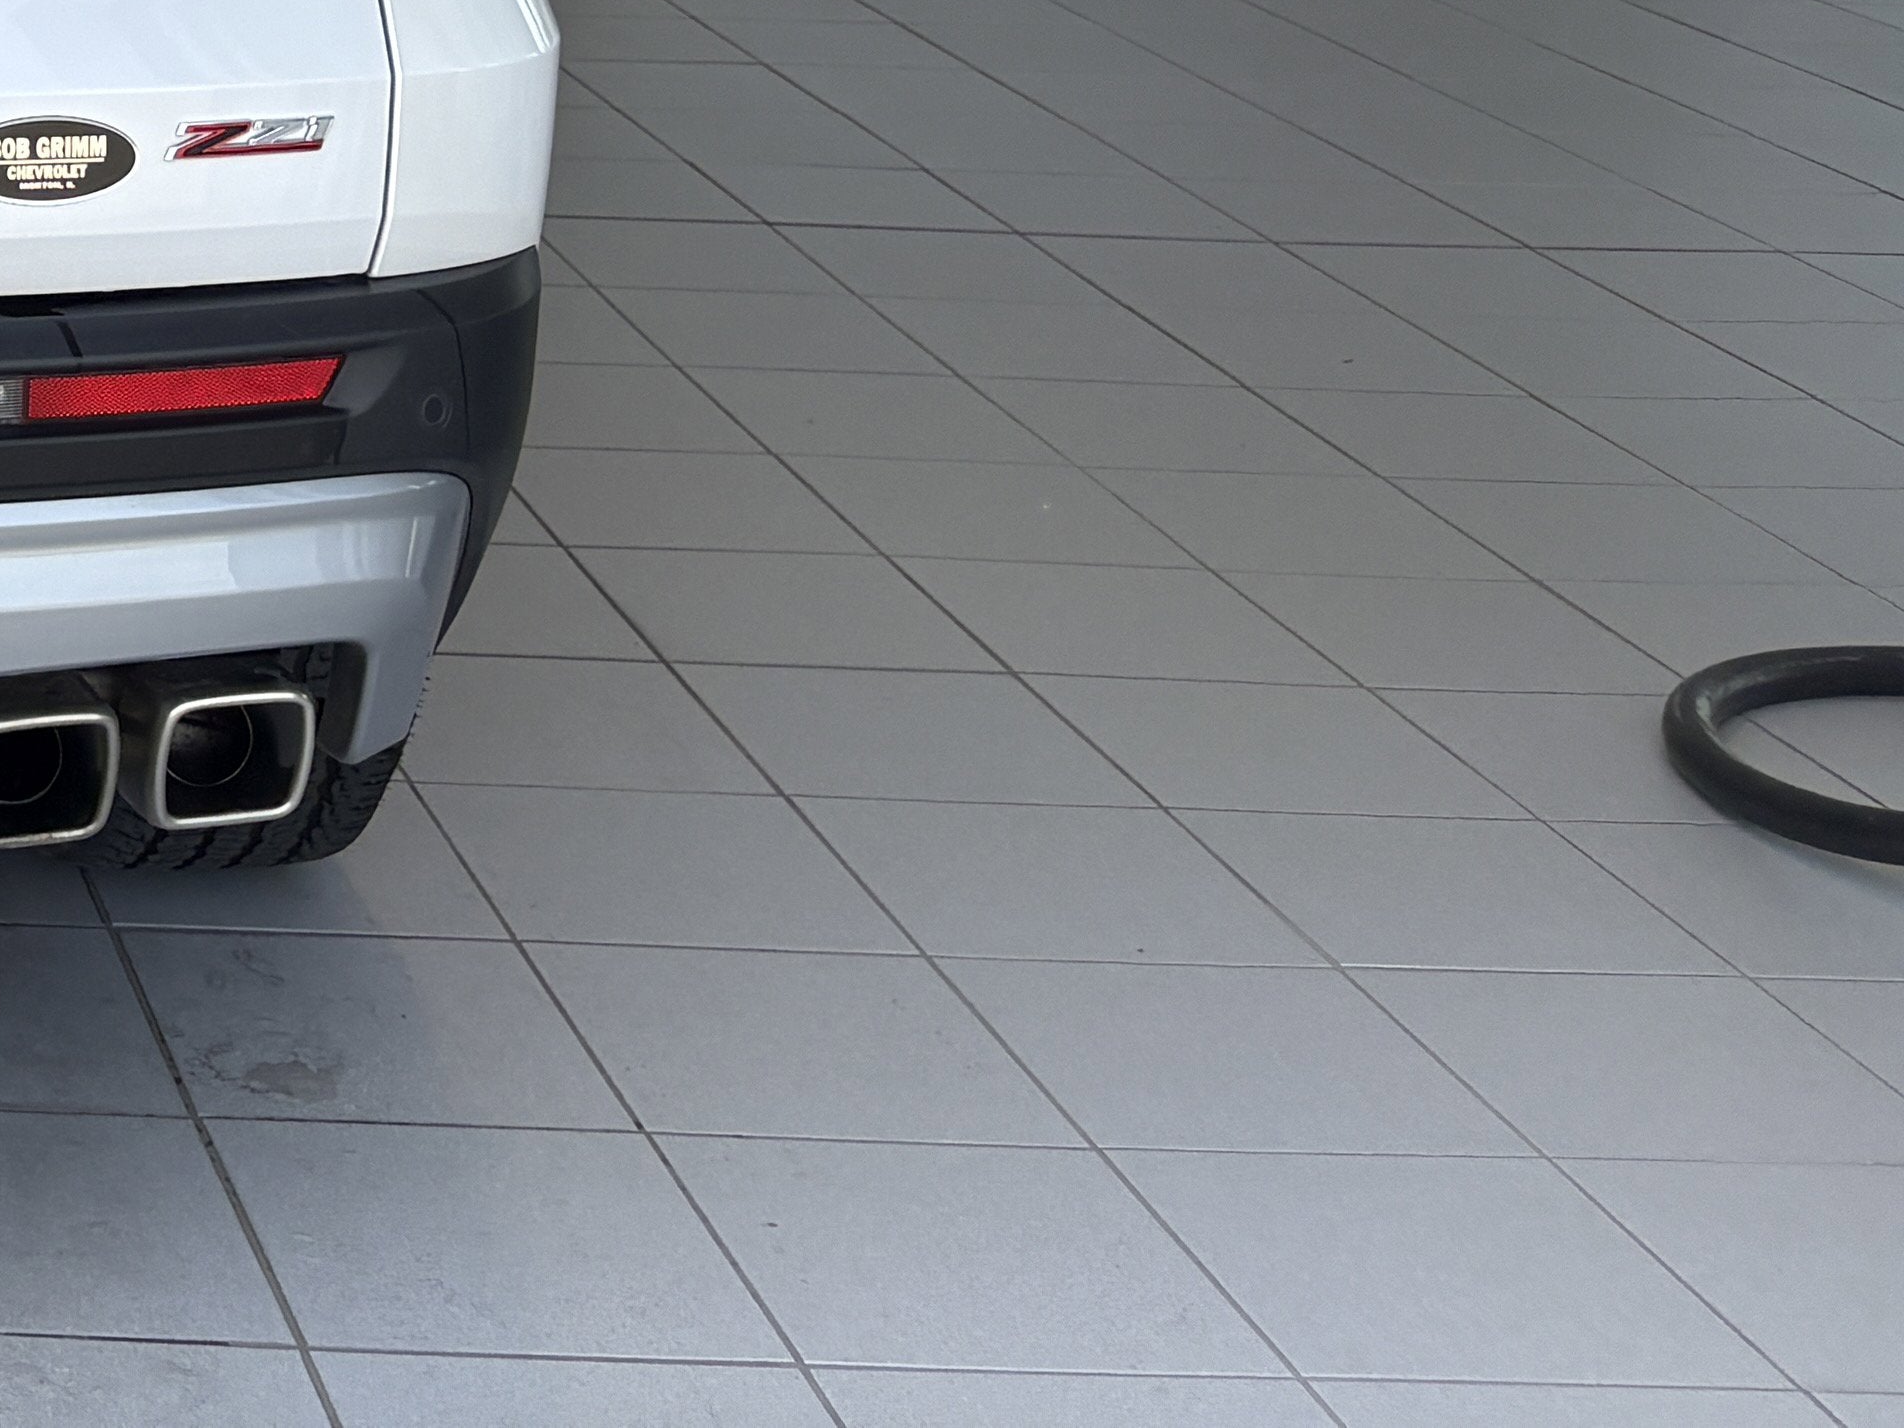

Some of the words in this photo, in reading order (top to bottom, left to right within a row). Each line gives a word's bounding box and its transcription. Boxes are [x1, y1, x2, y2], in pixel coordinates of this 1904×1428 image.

[35, 135, 107, 159] GRIMM
[163, 115, 336, 163] Z71
[6, 163, 88, 181] CHEVROLET
